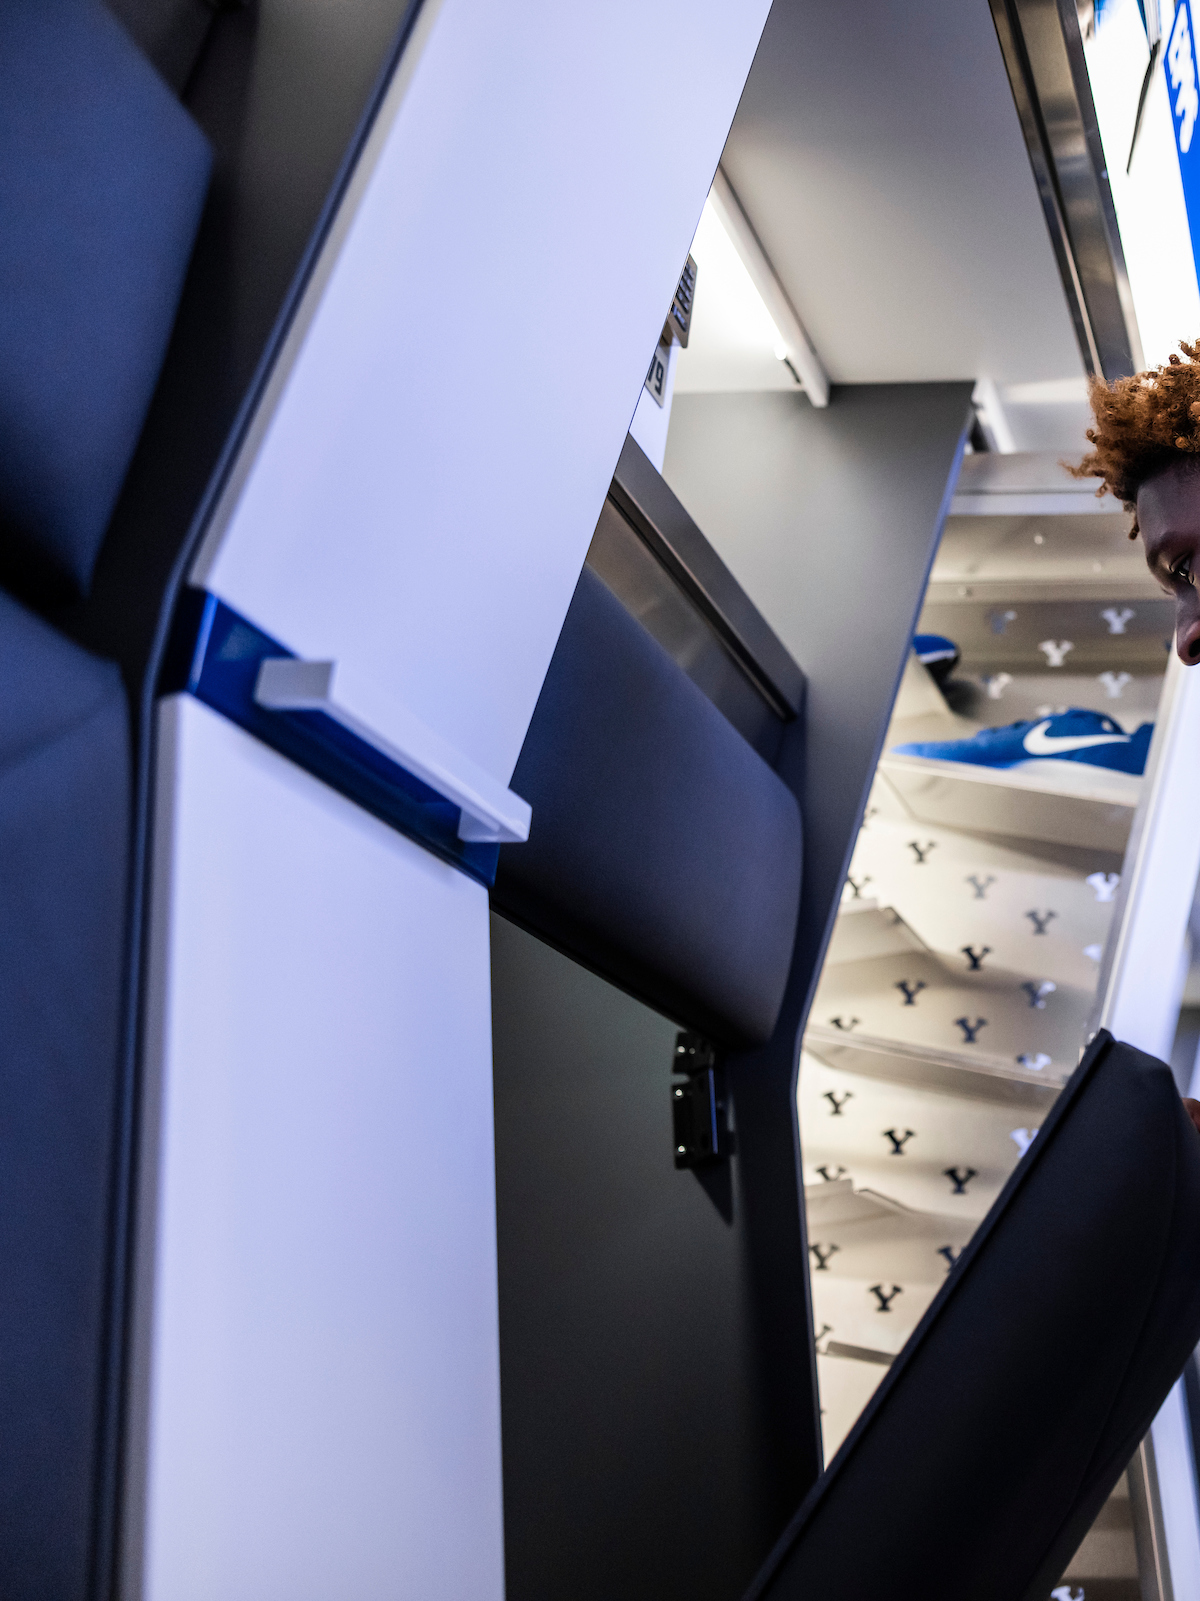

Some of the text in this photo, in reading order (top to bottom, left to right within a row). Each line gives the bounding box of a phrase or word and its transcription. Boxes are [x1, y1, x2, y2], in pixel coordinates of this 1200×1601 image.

[1102, 607, 1135, 635] Y
[1038, 638, 1074, 667] Y
[1098, 671, 1134, 698] Y
[908, 841, 936, 864] Y
[966, 875, 996, 899] Y
[1086, 872, 1120, 902] Y
[1025, 910, 1057, 935] Y
[961, 946, 992, 971] Y
[895, 980, 927, 1006] Y
[955, 1018, 988, 1044] Y
[823, 1091, 854, 1115] Y
[882, 1128, 916, 1155] Y
[943, 1167, 978, 1194] Y
[808, 1244, 840, 1271] Y
[869, 1284, 903, 1313] Y
